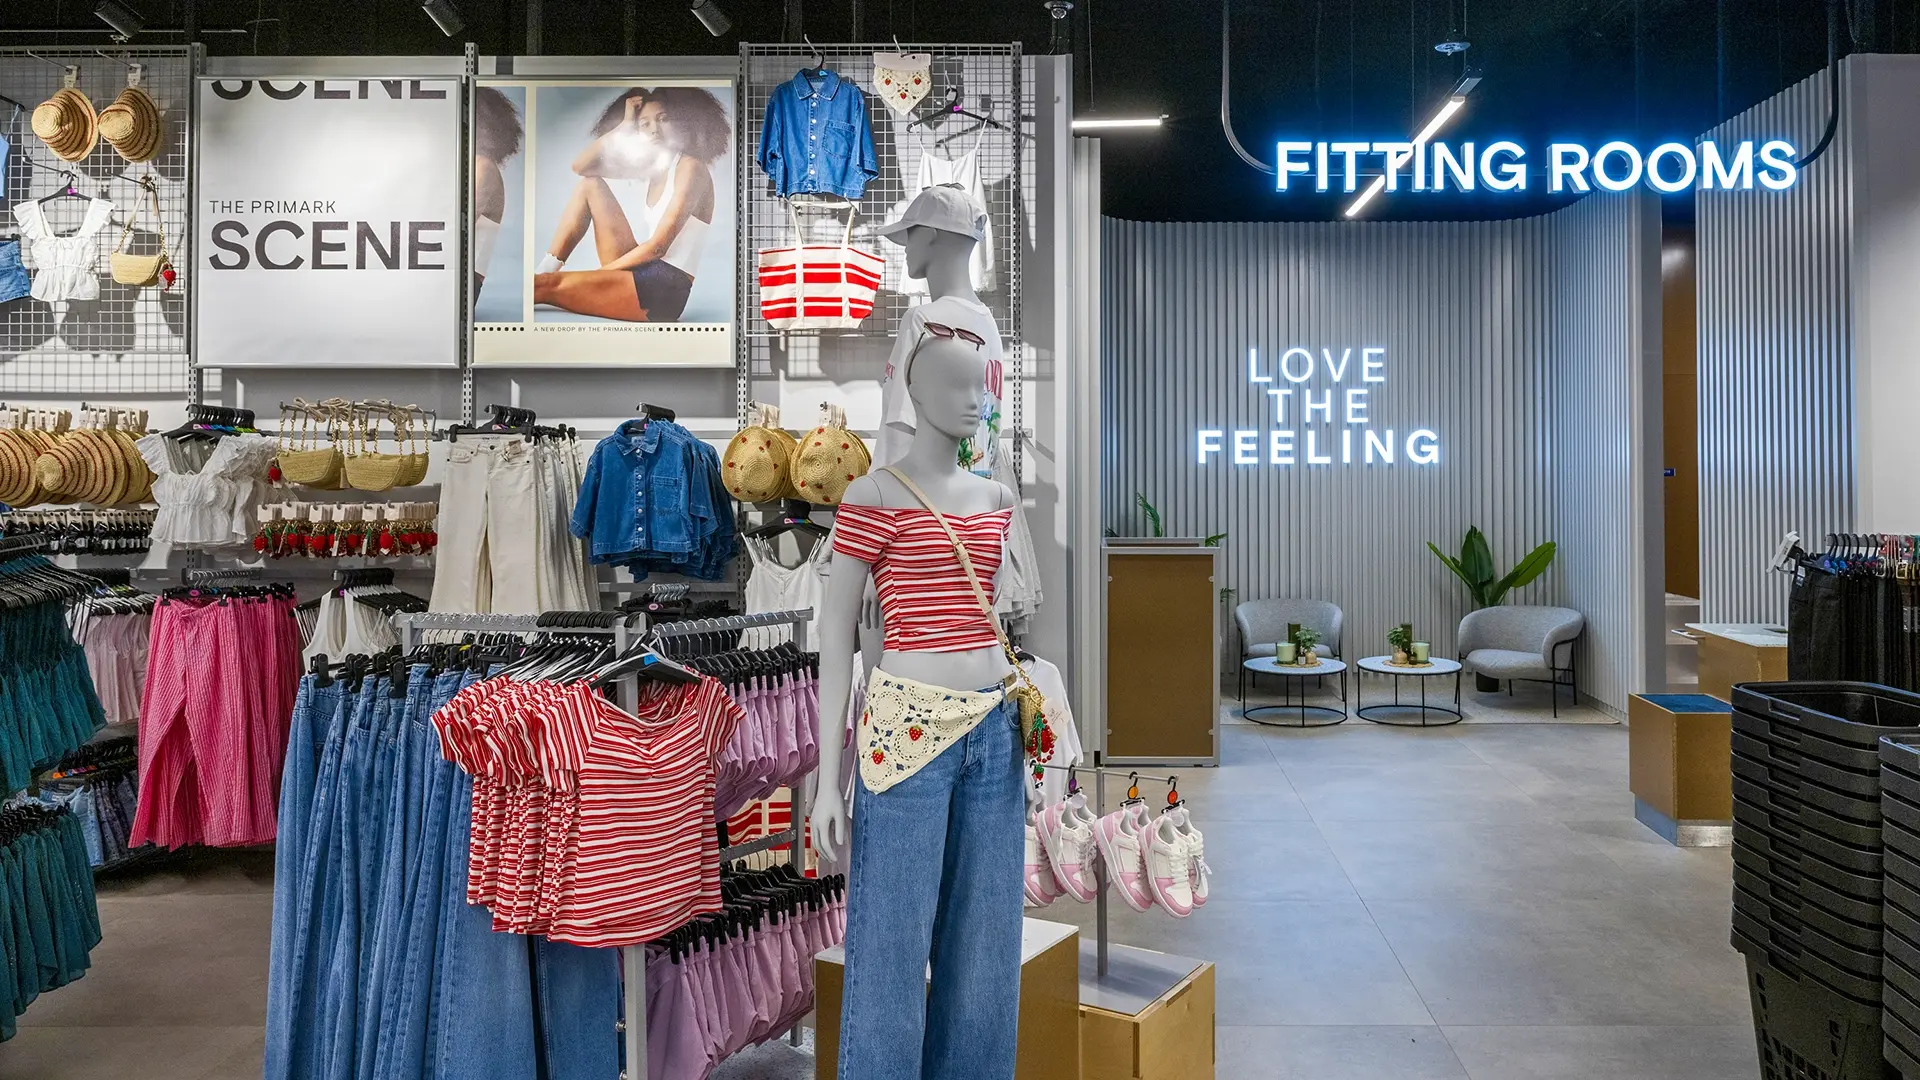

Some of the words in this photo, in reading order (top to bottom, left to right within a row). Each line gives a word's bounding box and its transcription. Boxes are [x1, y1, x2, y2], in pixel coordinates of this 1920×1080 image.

[1275, 141, 1527, 193] FITTING
[1547, 141, 1798, 193] ROOMS
[209, 200, 244, 214] THE
[251, 200, 336, 214] PRIMARK
[208, 220, 446, 270] SCENE
[1250, 347, 1385, 383] LOVE
[1267, 388, 1369, 423] THE
[1197, 429, 1440, 464] FEELING
